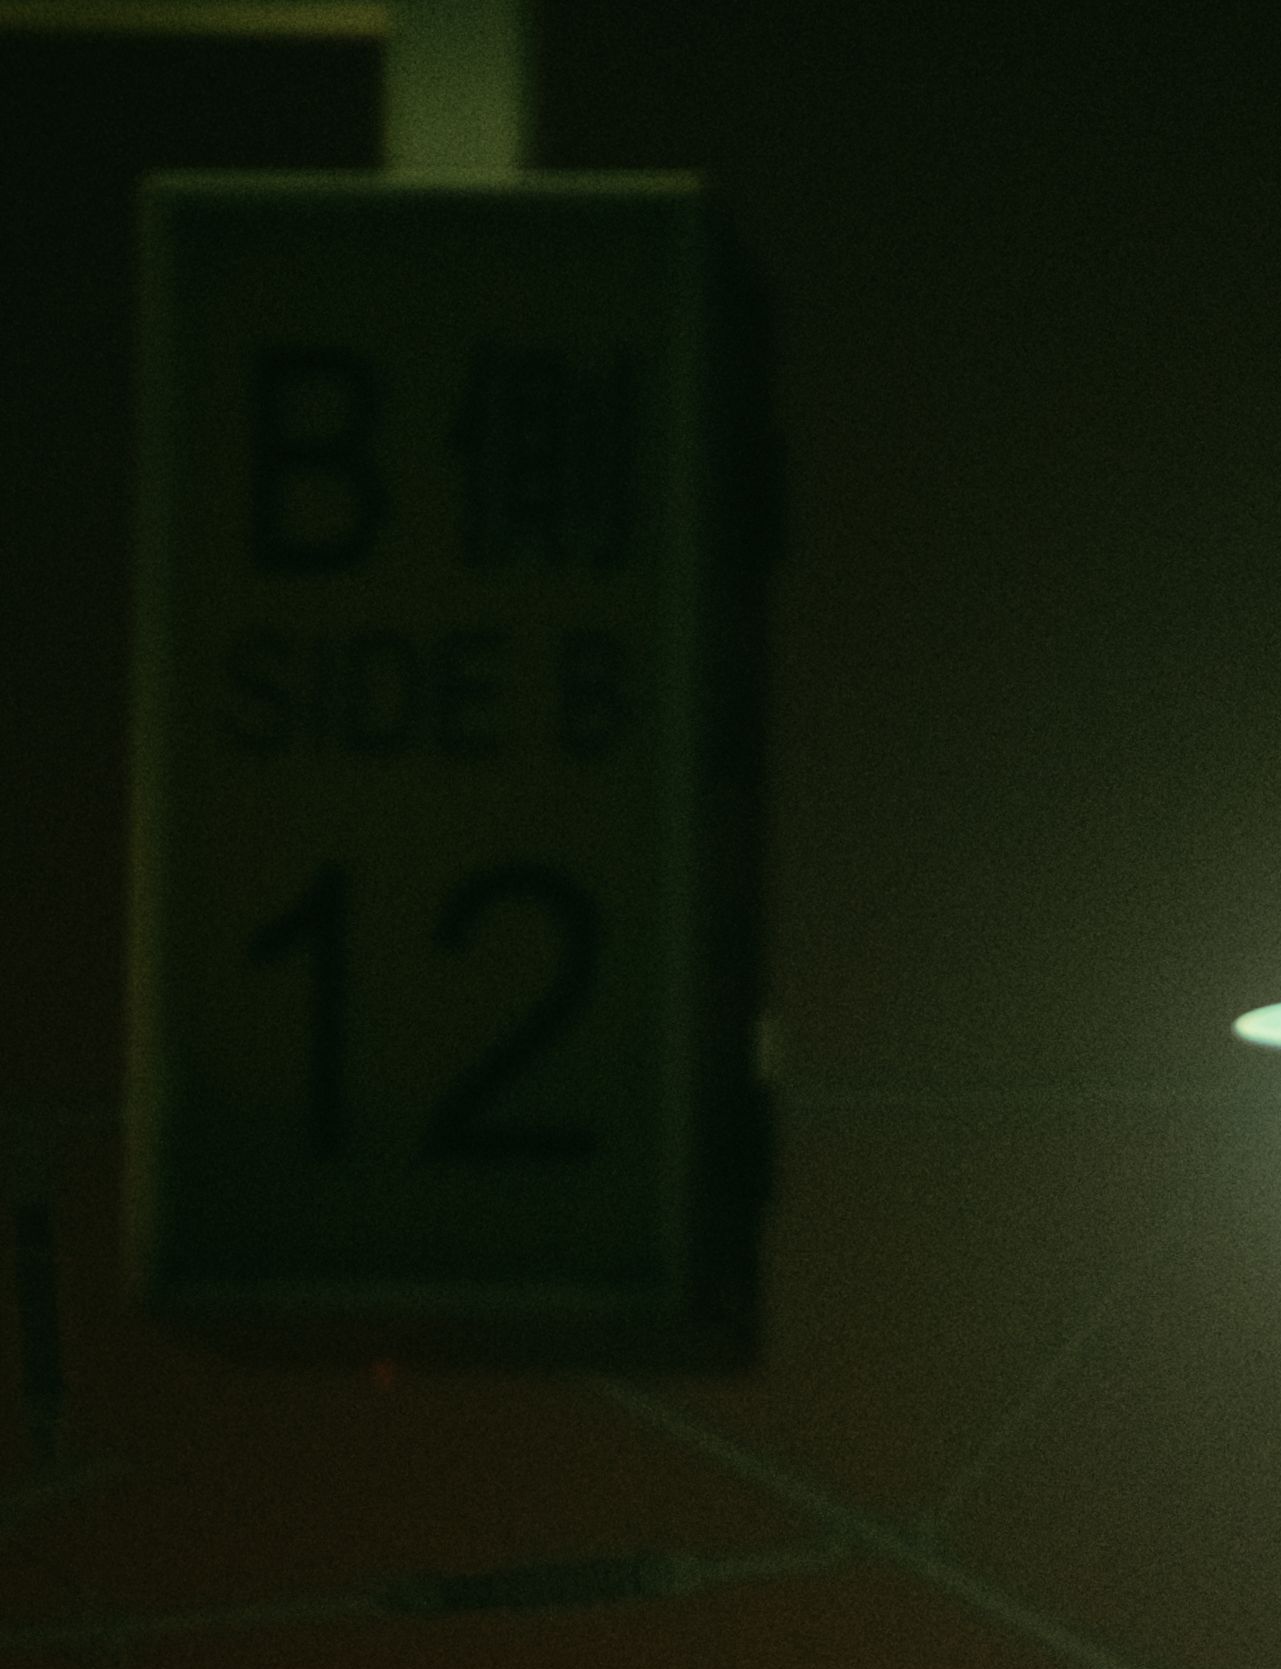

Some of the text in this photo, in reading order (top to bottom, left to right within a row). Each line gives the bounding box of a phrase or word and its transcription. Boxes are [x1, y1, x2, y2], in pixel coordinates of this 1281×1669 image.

[245, 340, 642, 577] B 側
[220, 627, 630, 760] SIDE B
[245, 858, 607, 1163] 12
